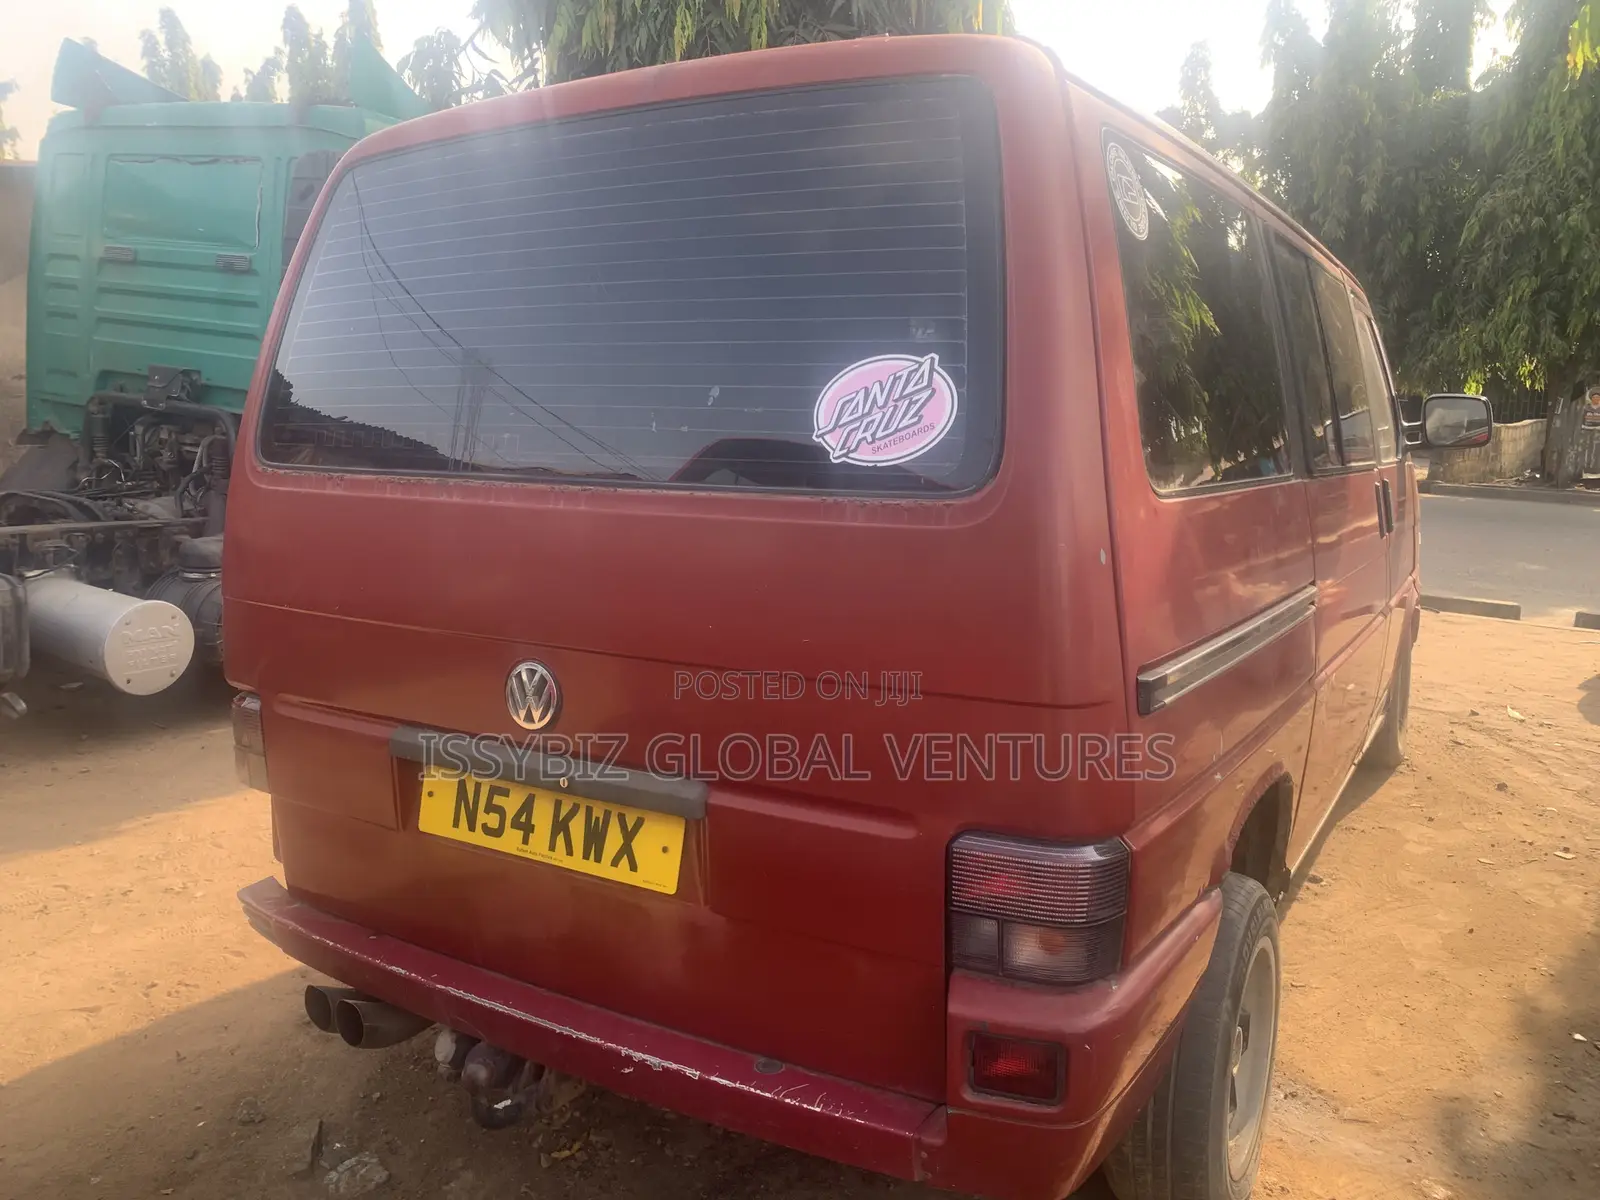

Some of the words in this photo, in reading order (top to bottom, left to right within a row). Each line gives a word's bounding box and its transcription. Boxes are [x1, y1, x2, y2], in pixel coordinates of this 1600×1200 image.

[815, 356, 936, 439] SANTA
[831, 387, 937, 460] CRUZ
[871, 422, 936, 455] SKATEBOARDS
[451, 778, 537, 847] N54
[547, 798, 646, 873] KWX
